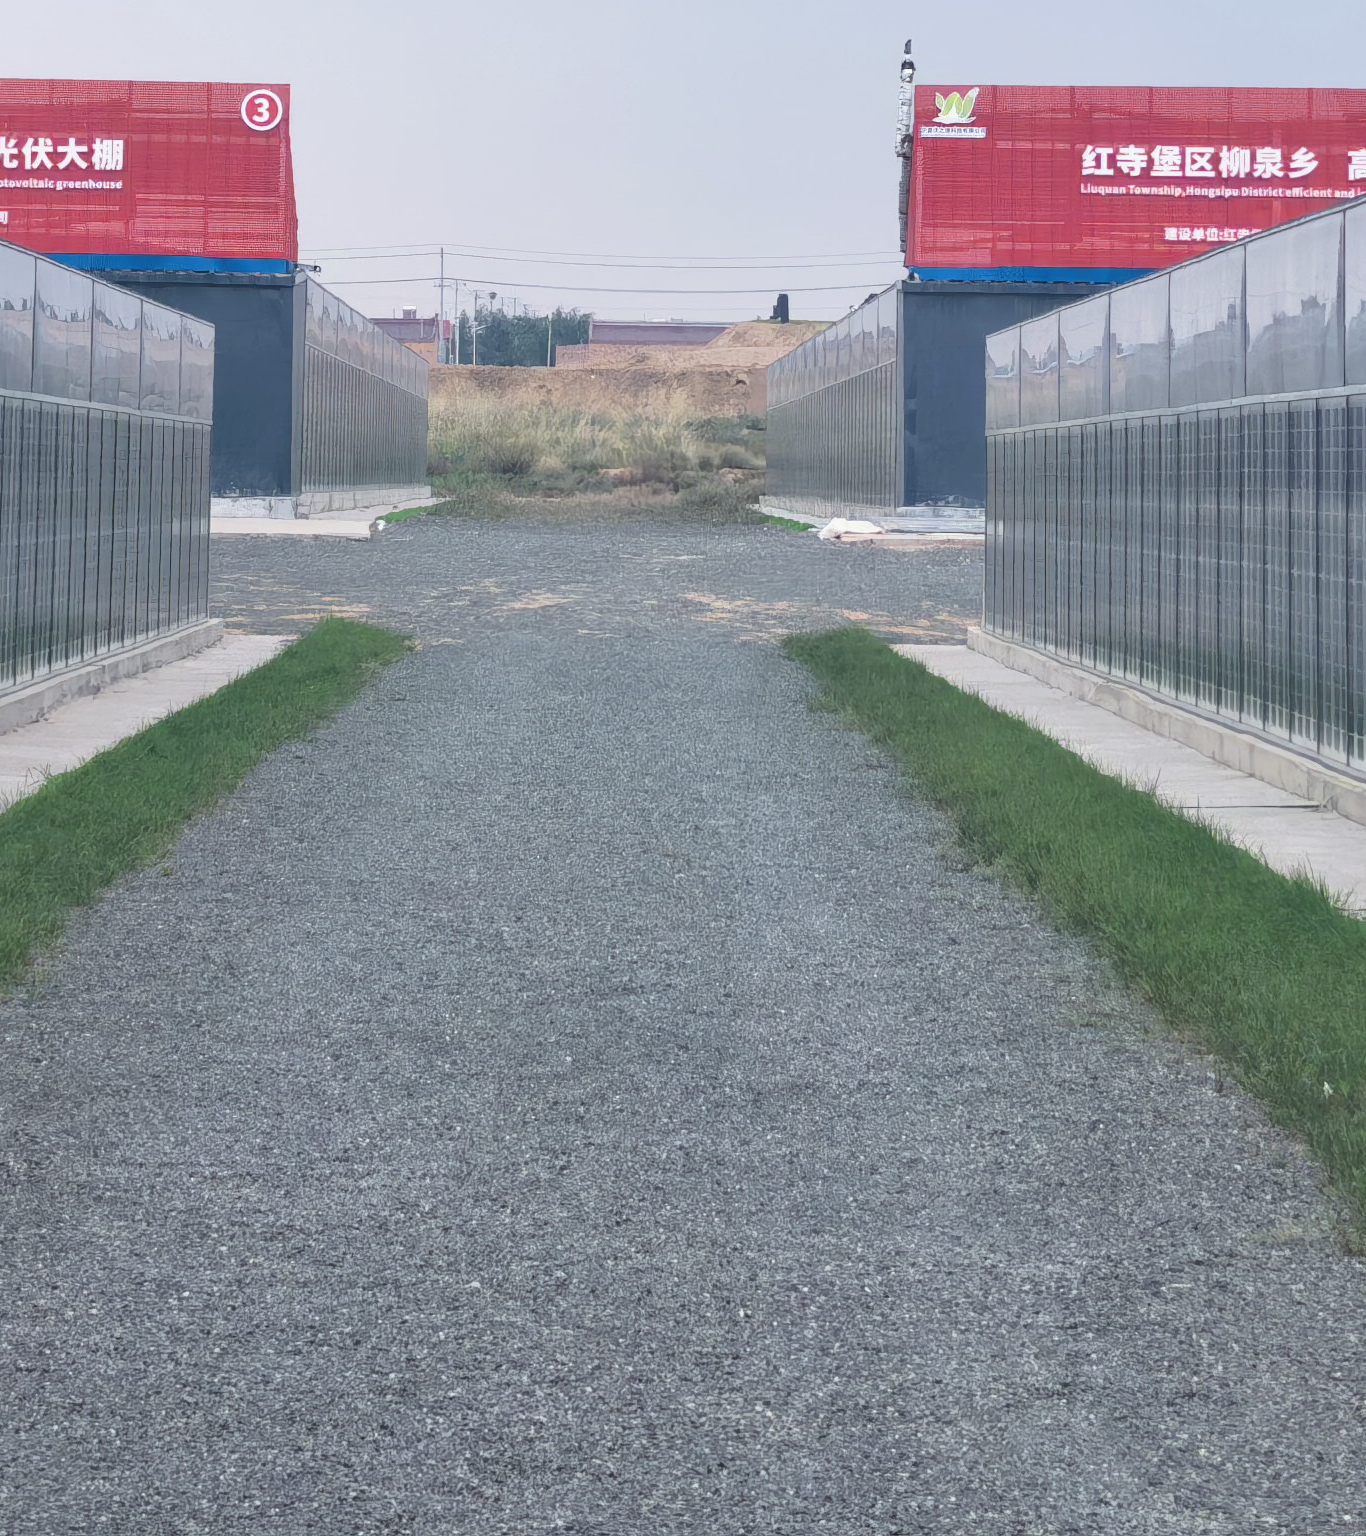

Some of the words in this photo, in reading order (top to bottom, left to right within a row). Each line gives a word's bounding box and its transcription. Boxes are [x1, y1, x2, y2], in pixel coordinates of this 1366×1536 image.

[252, 97, 270, 123] 3
[1081, 144, 1319, 179] 红寺堡区柳泉乡
[56, 179, 123, 191] greenhouse
[1080, 183, 1126, 196] Liuquan
[1241, 186, 1283, 197] District
[1285, 186, 1332, 198] efficient
[1334, 188, 1355, 199] and
